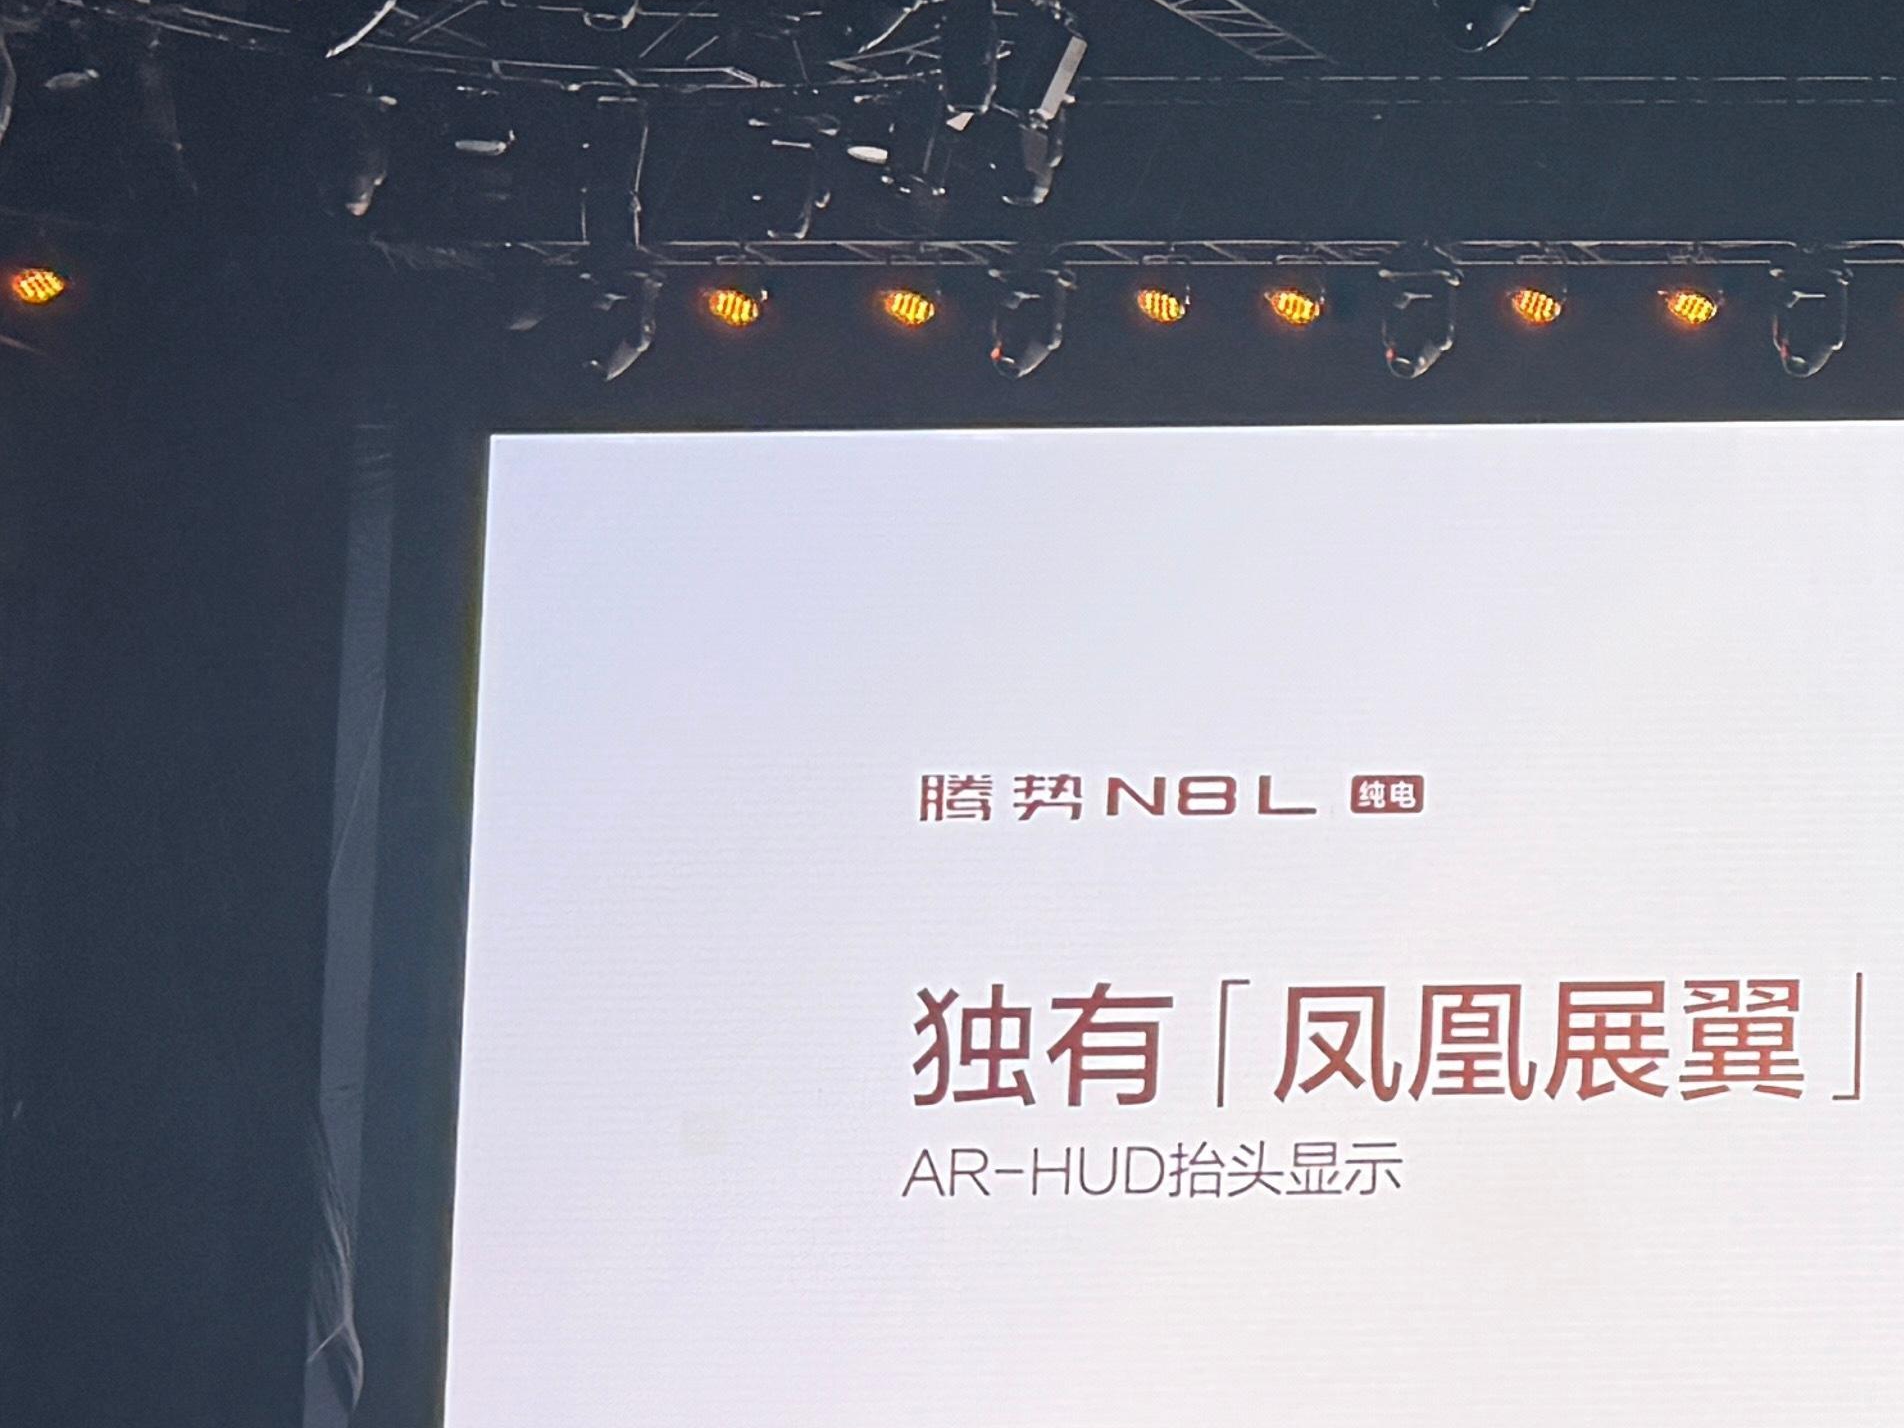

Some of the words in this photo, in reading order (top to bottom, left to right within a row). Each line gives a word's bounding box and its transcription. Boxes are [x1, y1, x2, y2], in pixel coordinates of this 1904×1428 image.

[1357, 781, 1418, 809] 纯电
[900, 1140, 1404, 1199] AR-HUD抬头显示
